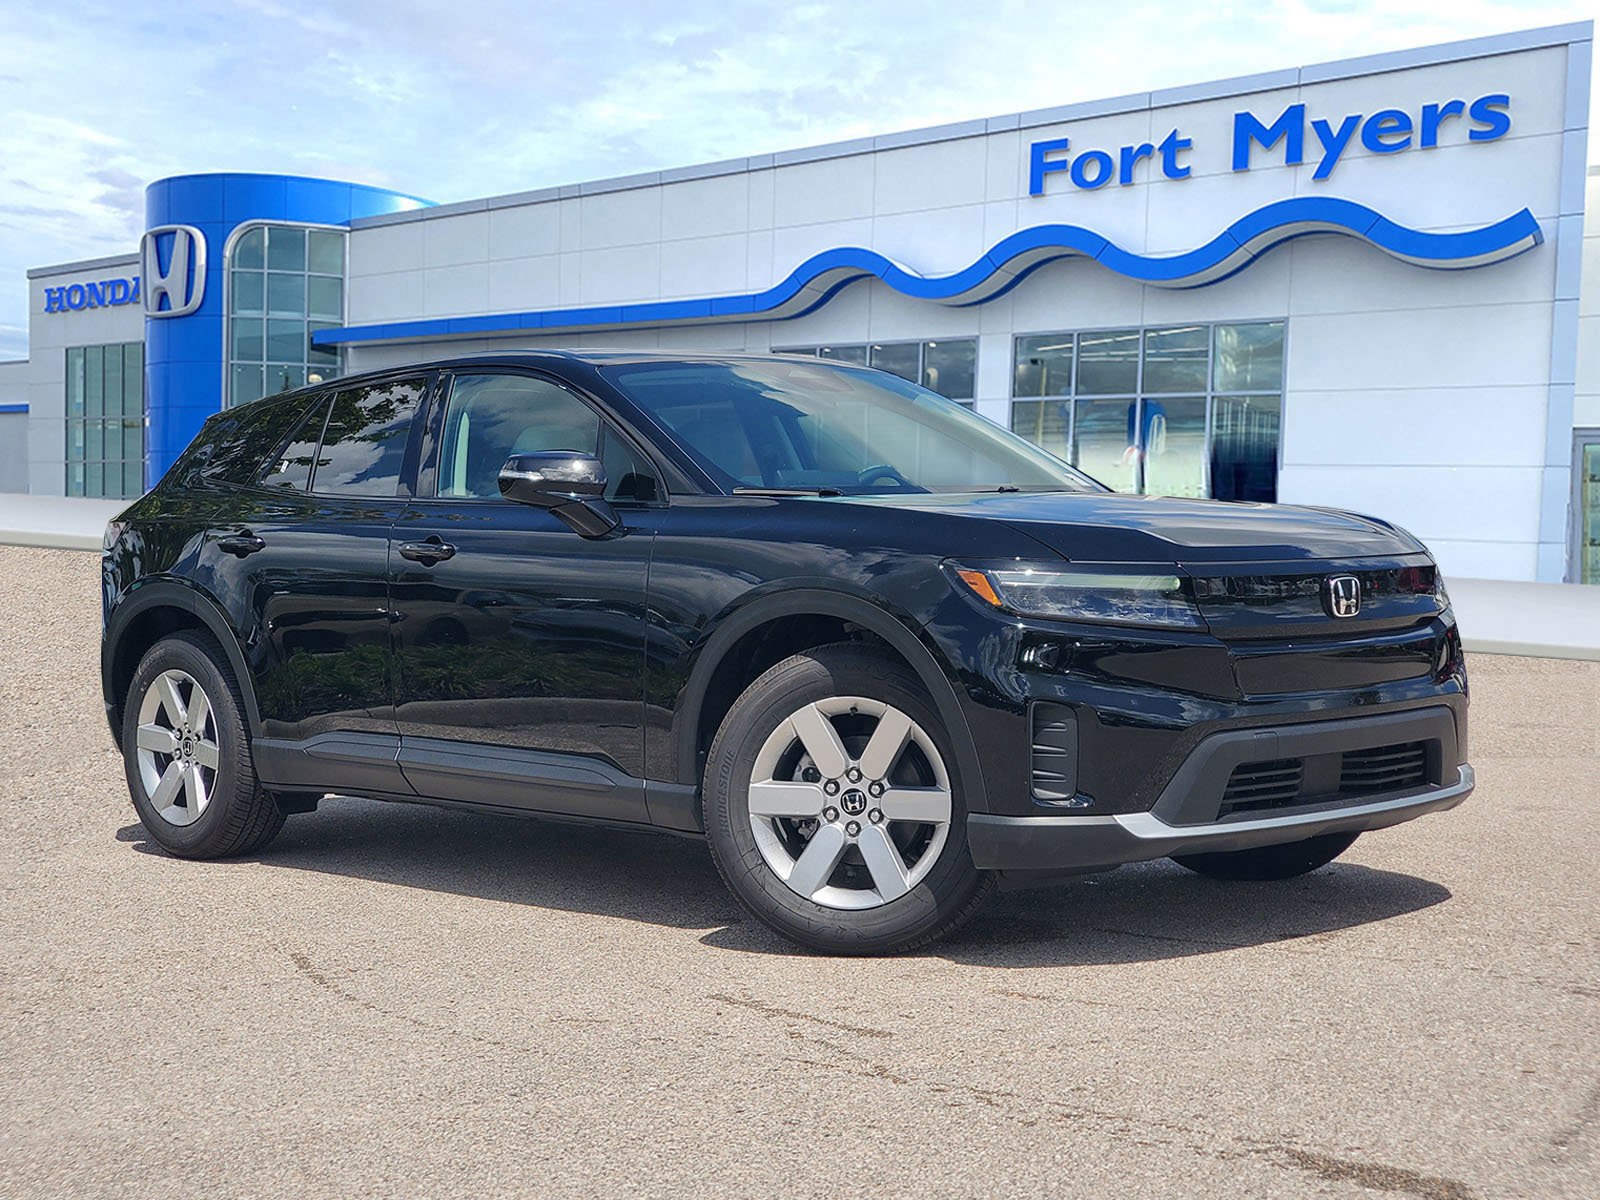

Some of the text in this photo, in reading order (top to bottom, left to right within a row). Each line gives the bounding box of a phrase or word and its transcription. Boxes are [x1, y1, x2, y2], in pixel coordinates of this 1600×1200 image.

[1029, 93, 1512, 197] Fort Myers
[718, 748, 736, 840] BRIDGESTONE
